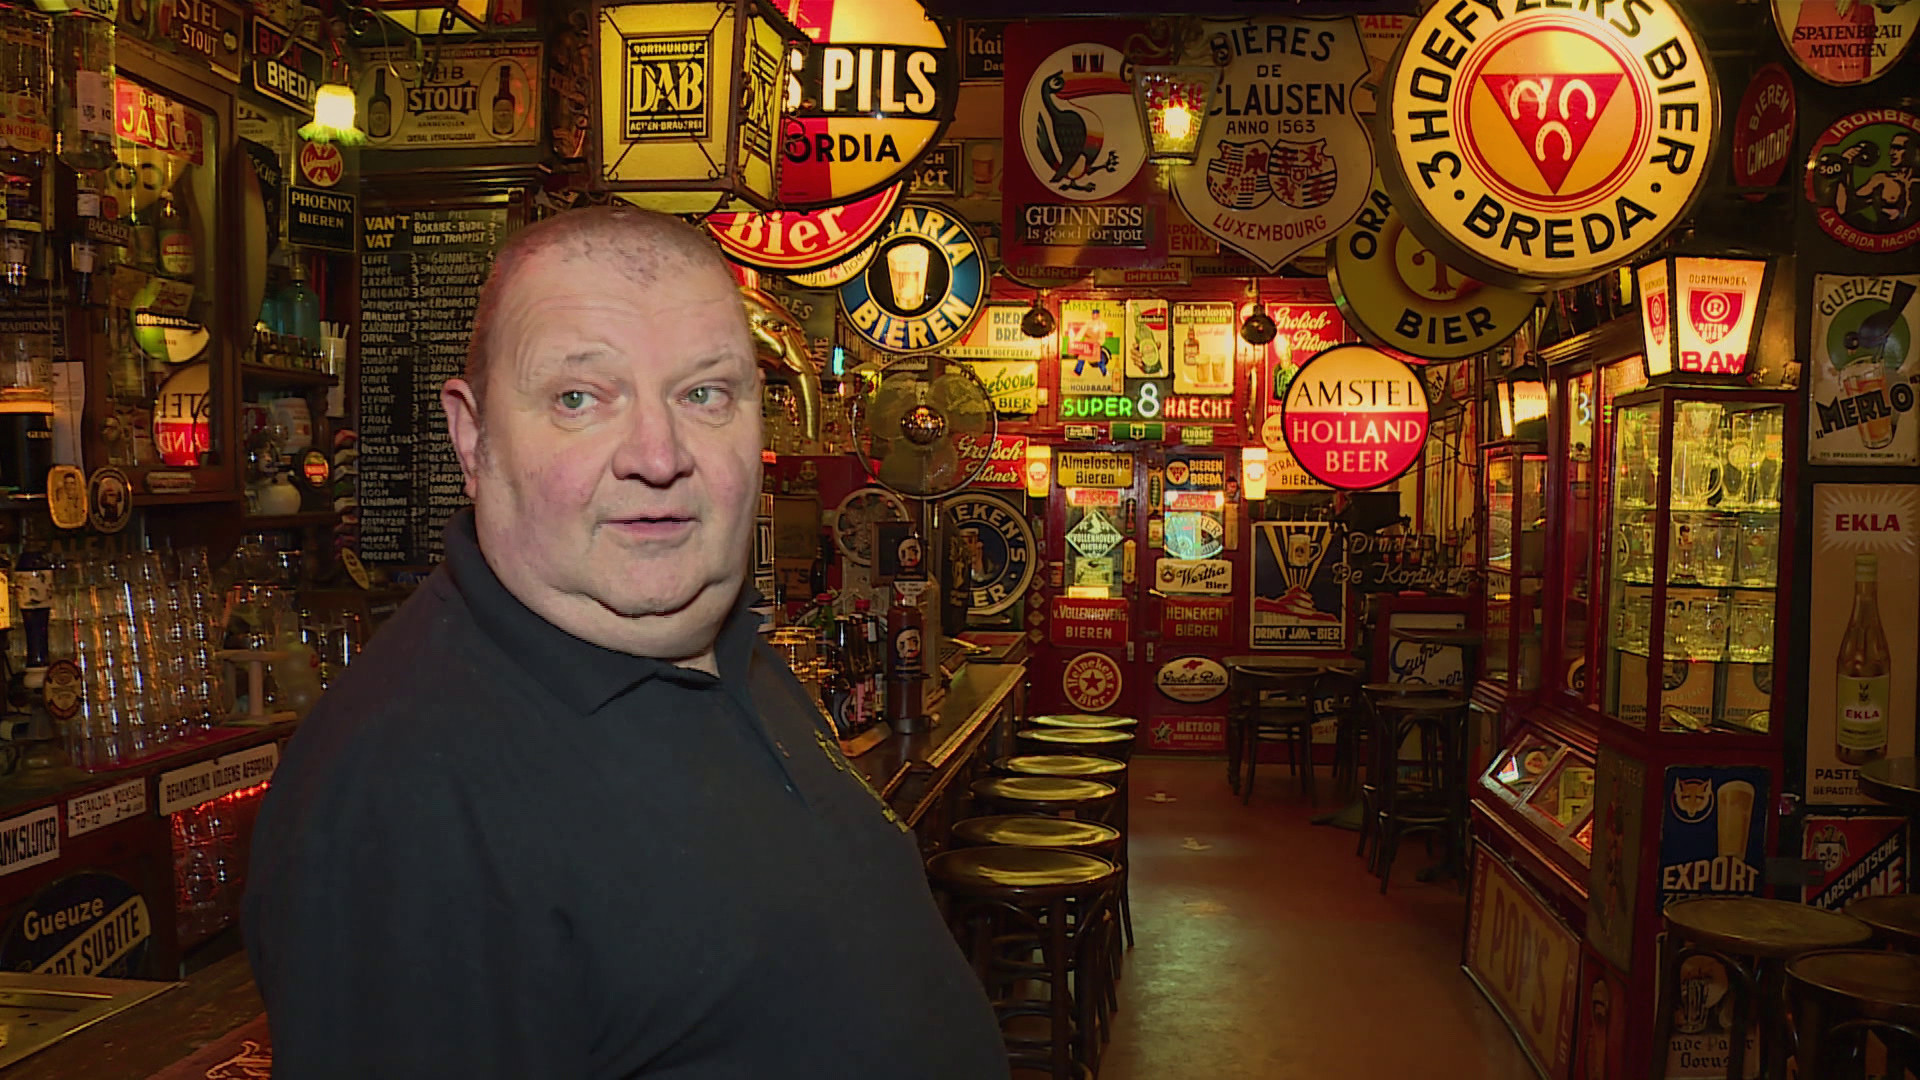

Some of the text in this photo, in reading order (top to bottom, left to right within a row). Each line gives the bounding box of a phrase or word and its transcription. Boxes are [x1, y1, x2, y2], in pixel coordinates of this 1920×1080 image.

[1364, 14, 1404, 29] ALE
[181, 24, 219, 57] STOUT
[967, 26, 1004, 56] Kai
[267, 60, 317, 104] BREDA
[436, 67, 464, 80] HB
[822, 48, 937, 114] PILS
[1256, 63, 1282, 79] DE
[409, 86, 477, 112] STOUT
[630, 60, 704, 114] DAB
[1150, 82, 1203, 110] EKU
[1208, 83, 1346, 116] CLAUSEN
[1748, 82, 1792, 131] BIEREN
[1419, 149, 1463, 191] 3
[1644, 37, 1699, 176] BIER
[1829, 108, 1920, 139] IRONBEE
[1225, 118, 1317, 135] ANNO 1563
[784, 133, 901, 163] ORDIA
[1818, 162, 1842, 176] 500
[290, 191, 353, 214] PHOENIX
[87, 216, 130, 240] BACARDI
[298, 209, 345, 230] BIEREN
[1024, 204, 1144, 228] GUINNESS
[1212, 212, 1328, 243] LUXEMBOURG
[1349, 188, 1394, 261] ORA
[1462, 193, 1658, 259] BREDA
[364, 233, 395, 249] VAT
[442, 231, 486, 245] TRAPPIST
[723, 205, 849, 255] Bier
[887, 208, 975, 268] ARIA
[1043, 226, 1081, 246] good
[1085, 225, 1110, 241] for
[1111, 228, 1145, 247] you
[1819, 210, 1920, 249] LA BEBIDA NACIO
[1170, 237, 1211, 250] ENIX
[1688, 273, 1747, 286] DORTMUNDER
[1819, 277, 1892, 317] GUEUZE
[850, 294, 973, 350] BIEREN
[992, 311, 1026, 326] BIER
[1394, 306, 1497, 346] BIER
[361, 333, 394, 343] ORVAL
[995, 327, 1026, 342] BRE
[1291, 329, 1340, 352] Pilsner
[998, 396, 1032, 409] BIER
[1062, 382, 1233, 418] SUPER 8 HAECHT
[1294, 379, 1420, 407] AMSTEL
[1292, 420, 1422, 444] HOLLAND
[1060, 455, 1131, 470] Almelosche
[1189, 459, 1223, 473] BIEREN
[1326, 450, 1390, 472] BEER
[1075, 471, 1115, 485] Bieren
[1189, 474, 1223, 486] BREDA
[1077, 492, 1115, 503] JASCO
[1174, 496, 1213, 507] JASCO
[949, 503, 1026, 564] EKEN'S
[1835, 513, 1901, 532] EKLA
[1205, 581, 1230, 590] Bier
[1331, 561, 1471, 588] De Koninck
[972, 583, 1008, 608] ER
[1064, 625, 1113, 639] BIEREN
[1175, 623, 1219, 638] BIEREN
[1076, 693, 1106, 708] Bier
[1176, 721, 1221, 733] METEOR
[1845, 709, 1880, 721] EKLA
[165, 754, 274, 804] BEHANDELING VOLGENS AFSPRAAK
[1815, 768, 1860, 781] PASTE
[1662, 855, 1761, 892] EXPORT
[1815, 833, 1902, 911] AARSCHOTSCHE
[23, 896, 105, 942] Gueuze
[81, 900, 140, 977] SUBITE
